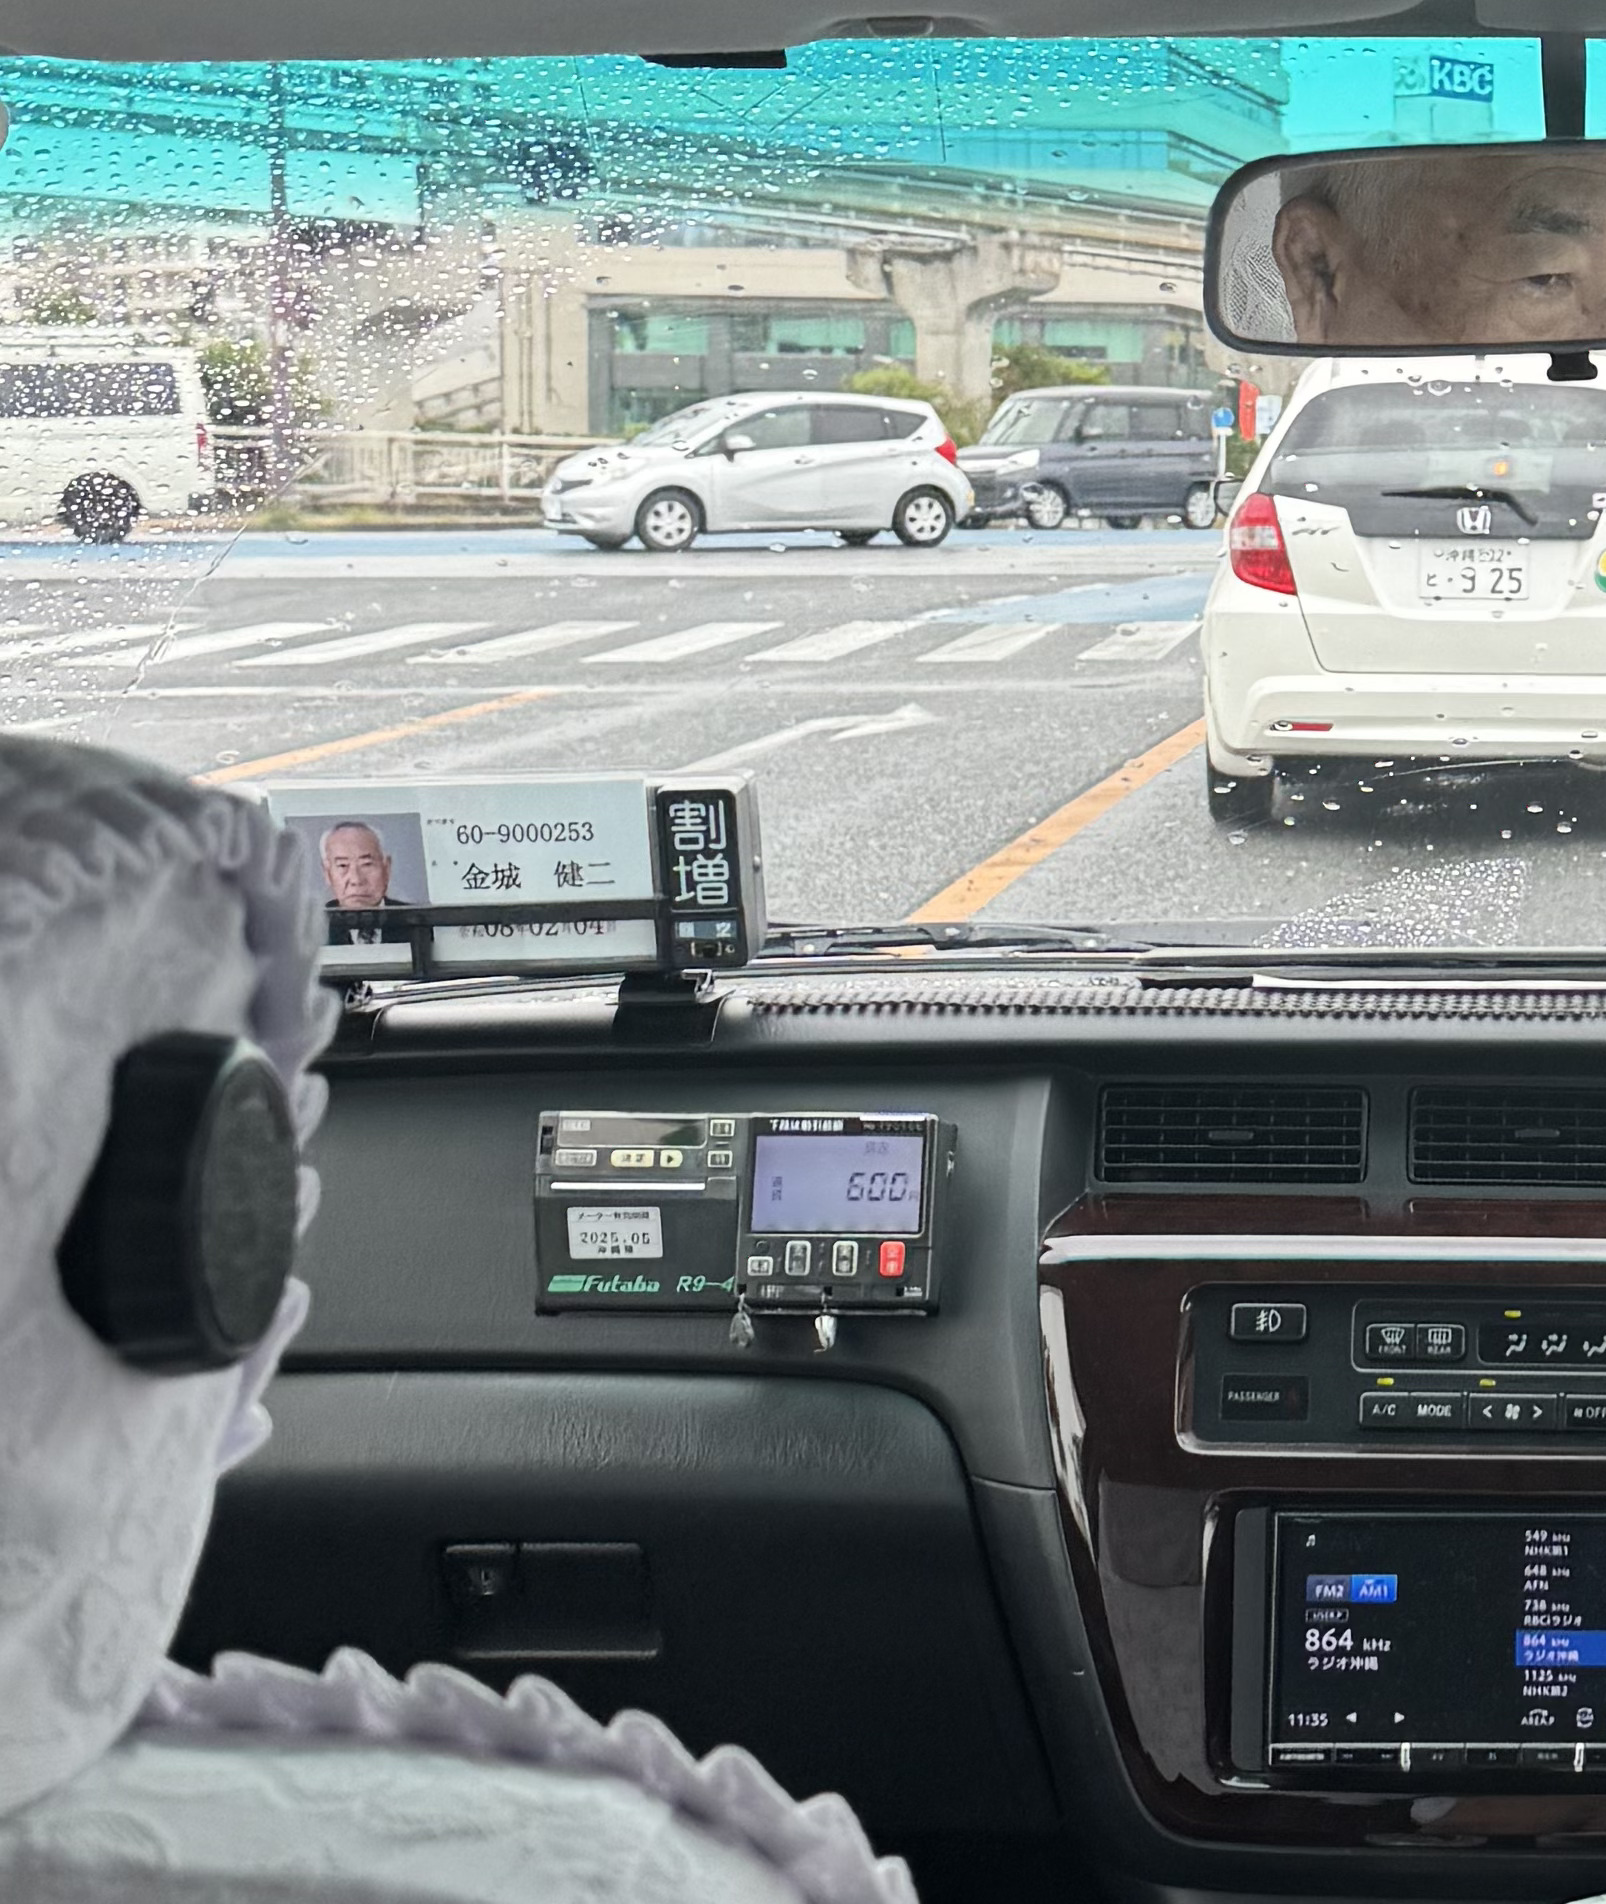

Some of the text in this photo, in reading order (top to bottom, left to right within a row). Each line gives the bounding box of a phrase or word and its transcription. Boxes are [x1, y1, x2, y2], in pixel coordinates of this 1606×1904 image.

[1431, 58, 1493, 95] KBC
[456, 821, 595, 845] 60-9000253
[669, 799, 730, 905] 割増
[461, 862, 522, 890] 金城
[583, 1274, 661, 1293] Futaba
[1227, 1391, 1281, 1403] PASSENGER
[1371, 1404, 1396, 1416] A/C
[1416, 1404, 1452, 1417] MODE
[1304, 1628, 1392, 1652] 864 kHz
[1287, 1712, 1329, 1727] 11:35
